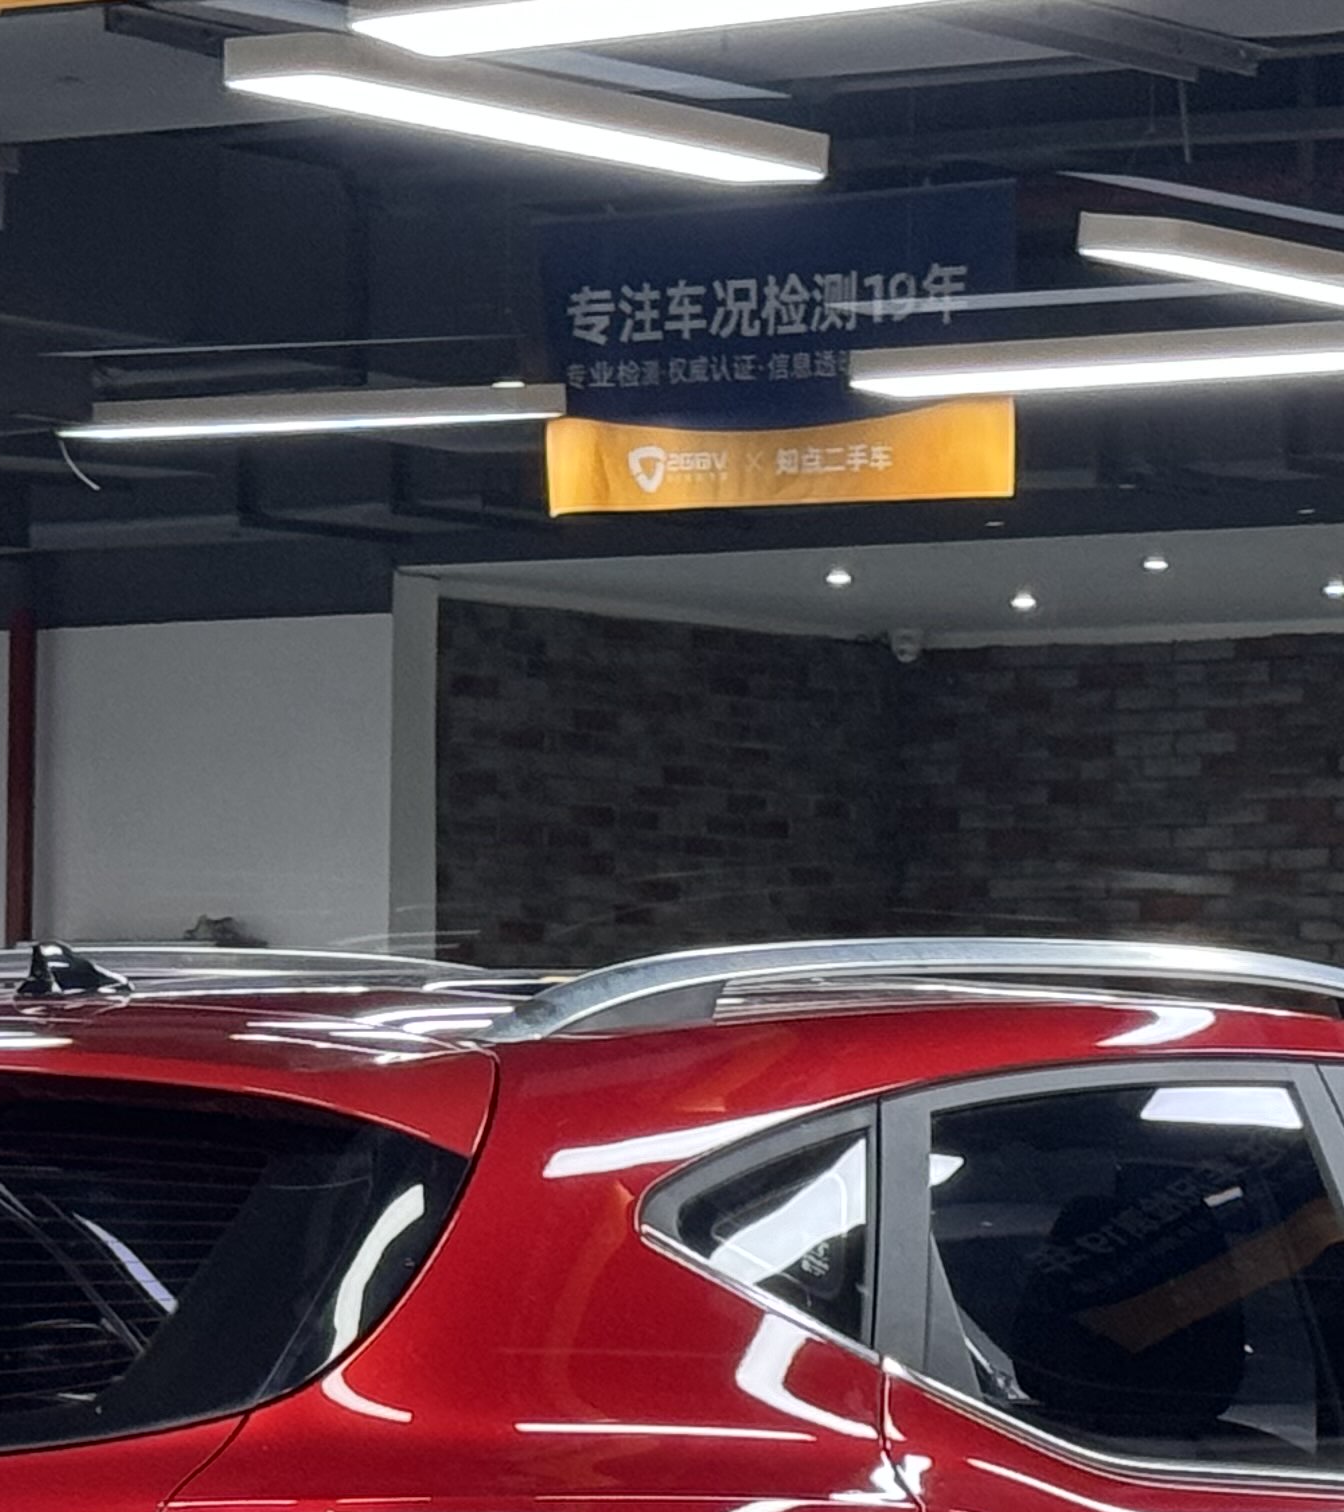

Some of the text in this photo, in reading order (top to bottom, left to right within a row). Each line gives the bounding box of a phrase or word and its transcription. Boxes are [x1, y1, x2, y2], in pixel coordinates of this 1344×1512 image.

[566, 262, 969, 346] 专注车况检测19年
[774, 443, 893, 477] 知点二手车
